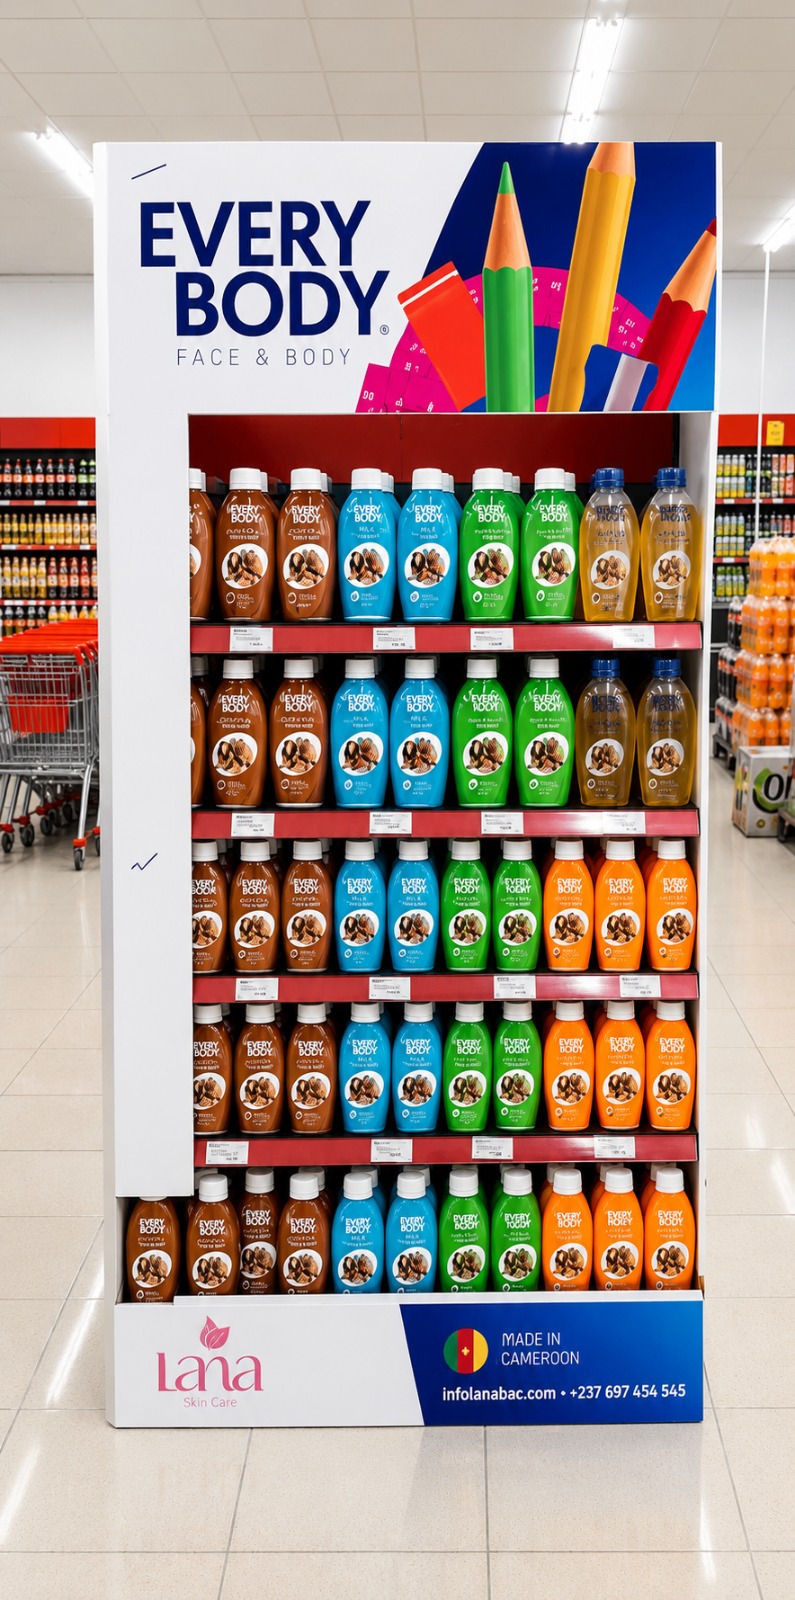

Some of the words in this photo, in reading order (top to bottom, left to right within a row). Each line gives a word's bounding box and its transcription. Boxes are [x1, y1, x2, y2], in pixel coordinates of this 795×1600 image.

[140, 201, 370, 268] EVERY
[176, 270, 389, 336] BODY
[177, 348, 240, 366] FACE
[256, 349, 268, 366] &
[286, 348, 350, 366] BODY
[231, 505, 259, 515] EVERY
[353, 505, 381, 515] EVERY
[415, 505, 442, 515] EVERY
[477, 505, 505, 515] EVERY
[231, 514, 260, 523] BODY
[354, 513, 382, 523] BODY
[415, 513, 442, 523] BODY
[478, 513, 505, 523] BODY
[541, 513, 568, 523] BODY
[222, 695, 250, 705] EVERY
[285, 695, 313, 705] EVERY
[348, 694, 374, 704] EVERY
[406, 694, 433, 704] EVERY
[222, 704, 250, 713] BODY
[285, 703, 313, 712] BODY
[348, 703, 374, 712] BODY
[407, 703, 434, 712] BODY
[294, 878, 319, 888] EVERY
[348, 878, 372, 888] EVERY
[401, 878, 426, 888] EVERY
[454, 878, 480, 887] EVERY
[557, 878, 582, 887] EVERY
[243, 887, 267, 895] BODY
[294, 886, 319, 895] BODY
[348, 885, 373, 895] BODY
[403, 885, 427, 895] BODY
[247, 1041, 273, 1050] EVERY
[298, 1040, 323, 1050] EVERY
[352, 1039, 377, 1049] EVERY
[406, 1039, 431, 1048] EVERY
[456, 1039, 481, 1048] EVERY
[559, 1038, 583, 1048] EVERY
[610, 1037, 634, 1047] EVERY
[660, 1038, 684, 1047] EVERY
[195, 1049, 219, 1057] BODY
[248, 1048, 273, 1057] BODY
[299, 1048, 323, 1057] BODY
[353, 1047, 378, 1055] BODY
[406, 1046, 431, 1055] BODY
[557, 1212, 581, 1221] EVERY
[658, 1211, 683, 1220] EVERY
[140, 1218, 165, 1227] EVERY
[246, 1216, 271, 1225] BODY
[290, 1218, 315, 1226] EVERY
[345, 1218, 371, 1226] EVERY
[401, 1216, 425, 1225] EVERY
[659, 1218, 683, 1226] BODY
[140, 1225, 165, 1234] BODY
[200, 1227, 225, 1235] BODY
[345, 1225, 372, 1234] BODY
[502, 1333, 542, 1346] MADE
[547, 1332, 561, 1346] IN
[501, 1351, 579, 1366] CAMEROON
[157, 1352, 264, 1392] Lana
[442, 1386, 556, 1401] infolanabac.com
[570, 1385, 601, 1399] +237
[605, 1385, 629, 1398] 697
[633, 1384, 657, 1398] 454
[661, 1384, 686, 1397] 545
[183, 1397, 207, 1408] Skin
[211, 1397, 237, 1408] Care
